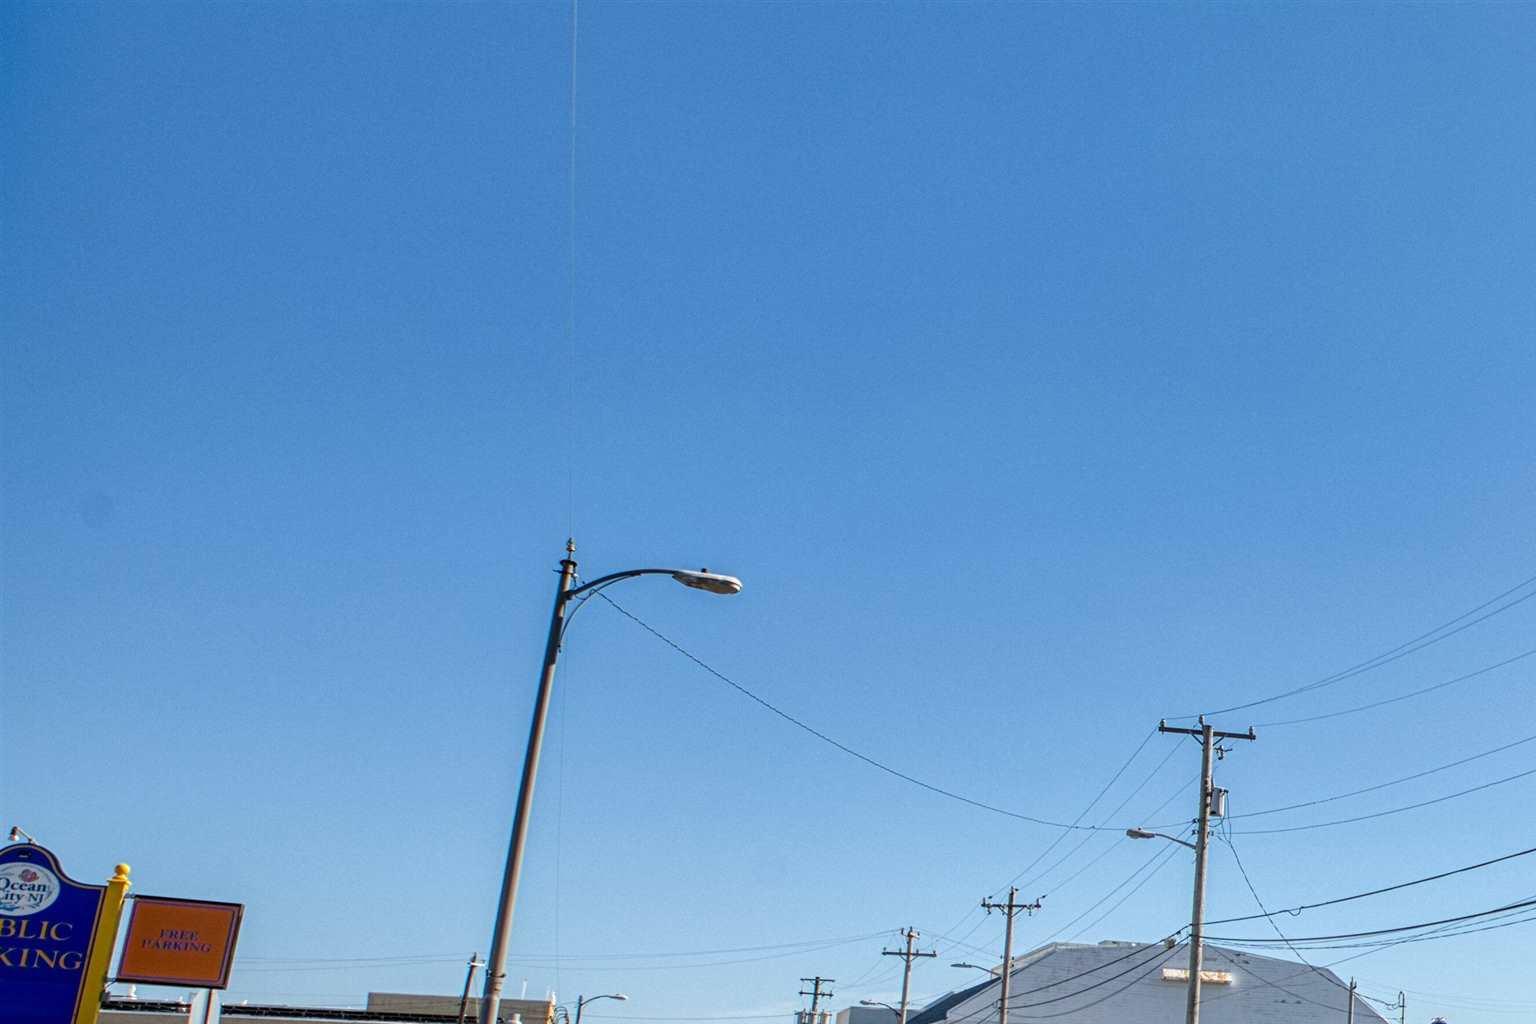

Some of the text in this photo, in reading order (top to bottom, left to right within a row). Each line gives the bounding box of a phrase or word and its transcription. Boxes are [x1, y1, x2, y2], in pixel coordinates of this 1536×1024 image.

[0, 890, 24, 904] ity
[159, 929, 200, 941] FREE
[141, 939, 212, 953] PARKING
